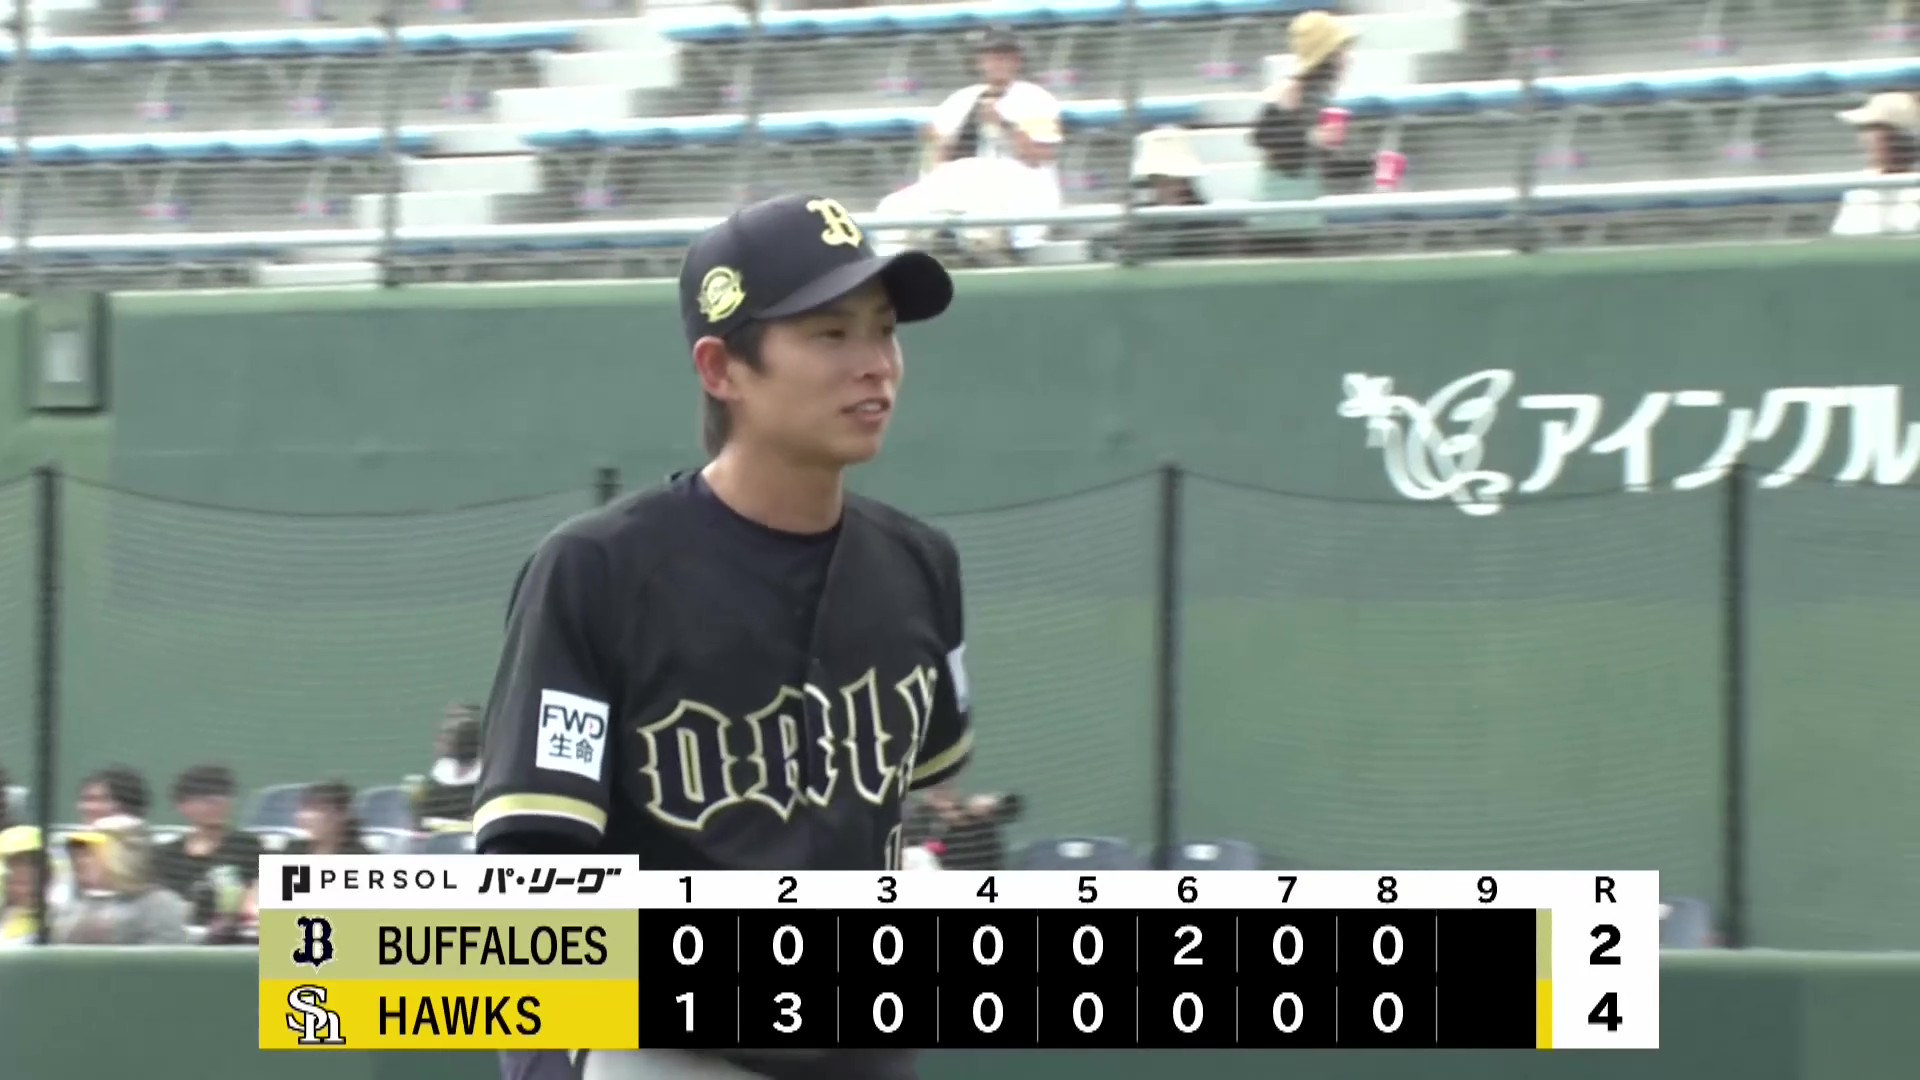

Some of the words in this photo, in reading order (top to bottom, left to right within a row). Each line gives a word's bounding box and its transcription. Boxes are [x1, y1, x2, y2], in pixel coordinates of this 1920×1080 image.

[806, 198, 863, 248] B
[542, 703, 605, 740] FWD
[548, 732, 595, 764] 生命
